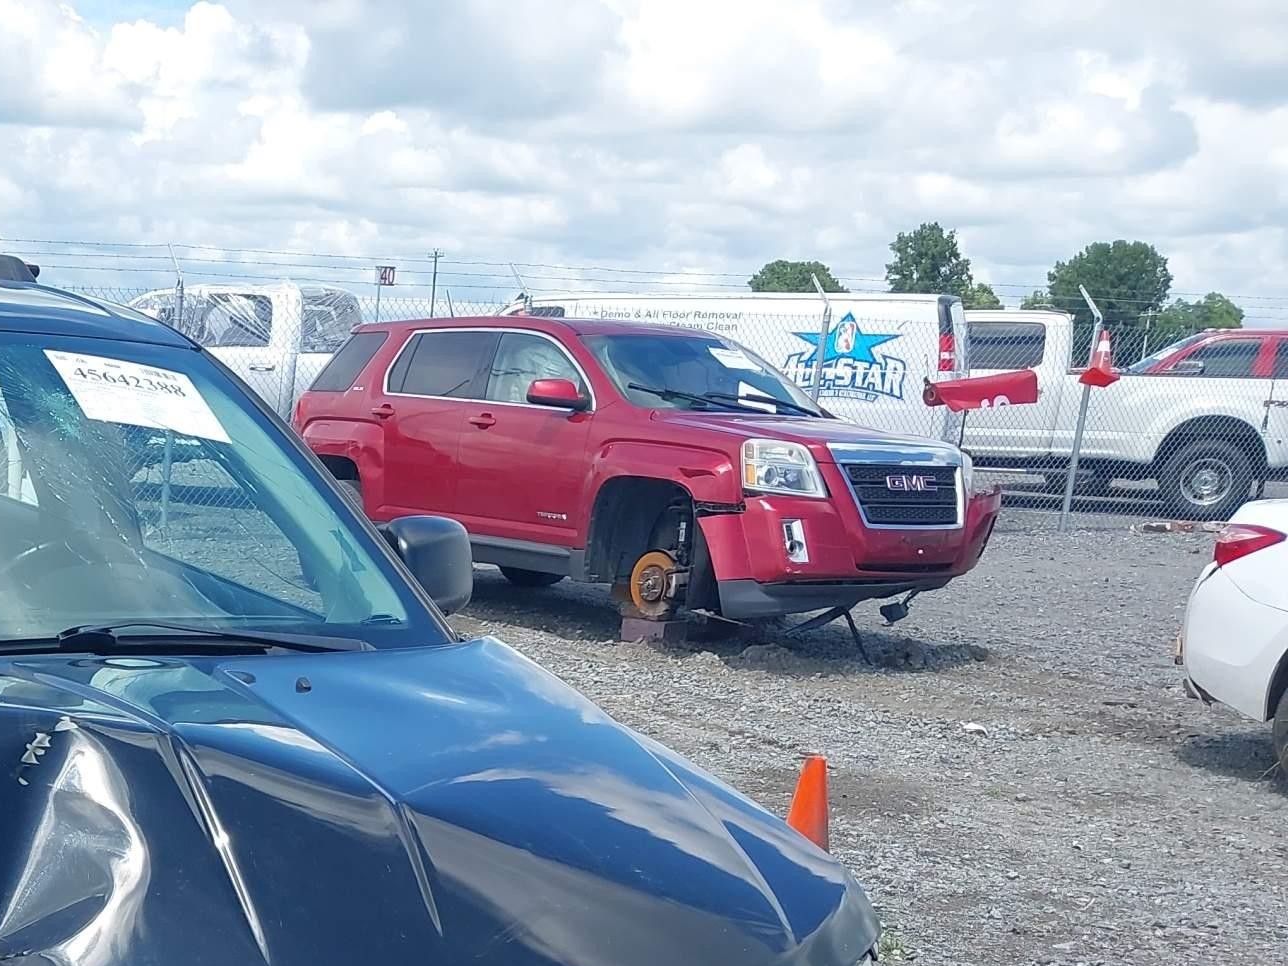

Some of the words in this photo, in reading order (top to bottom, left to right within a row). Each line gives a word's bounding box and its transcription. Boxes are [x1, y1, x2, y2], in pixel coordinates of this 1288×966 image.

[380, 267, 395, 284] 40
[600, 310, 631, 319] Demo
[634, 310, 642, 319] &
[645, 310, 660, 319] All
[663, 310, 692, 320] Floor
[694, 310, 743, 320] Removal
[706, 321, 738, 331] Clean
[73, 367, 187, 398] 45642388
[886, 475, 938, 491] GMC
